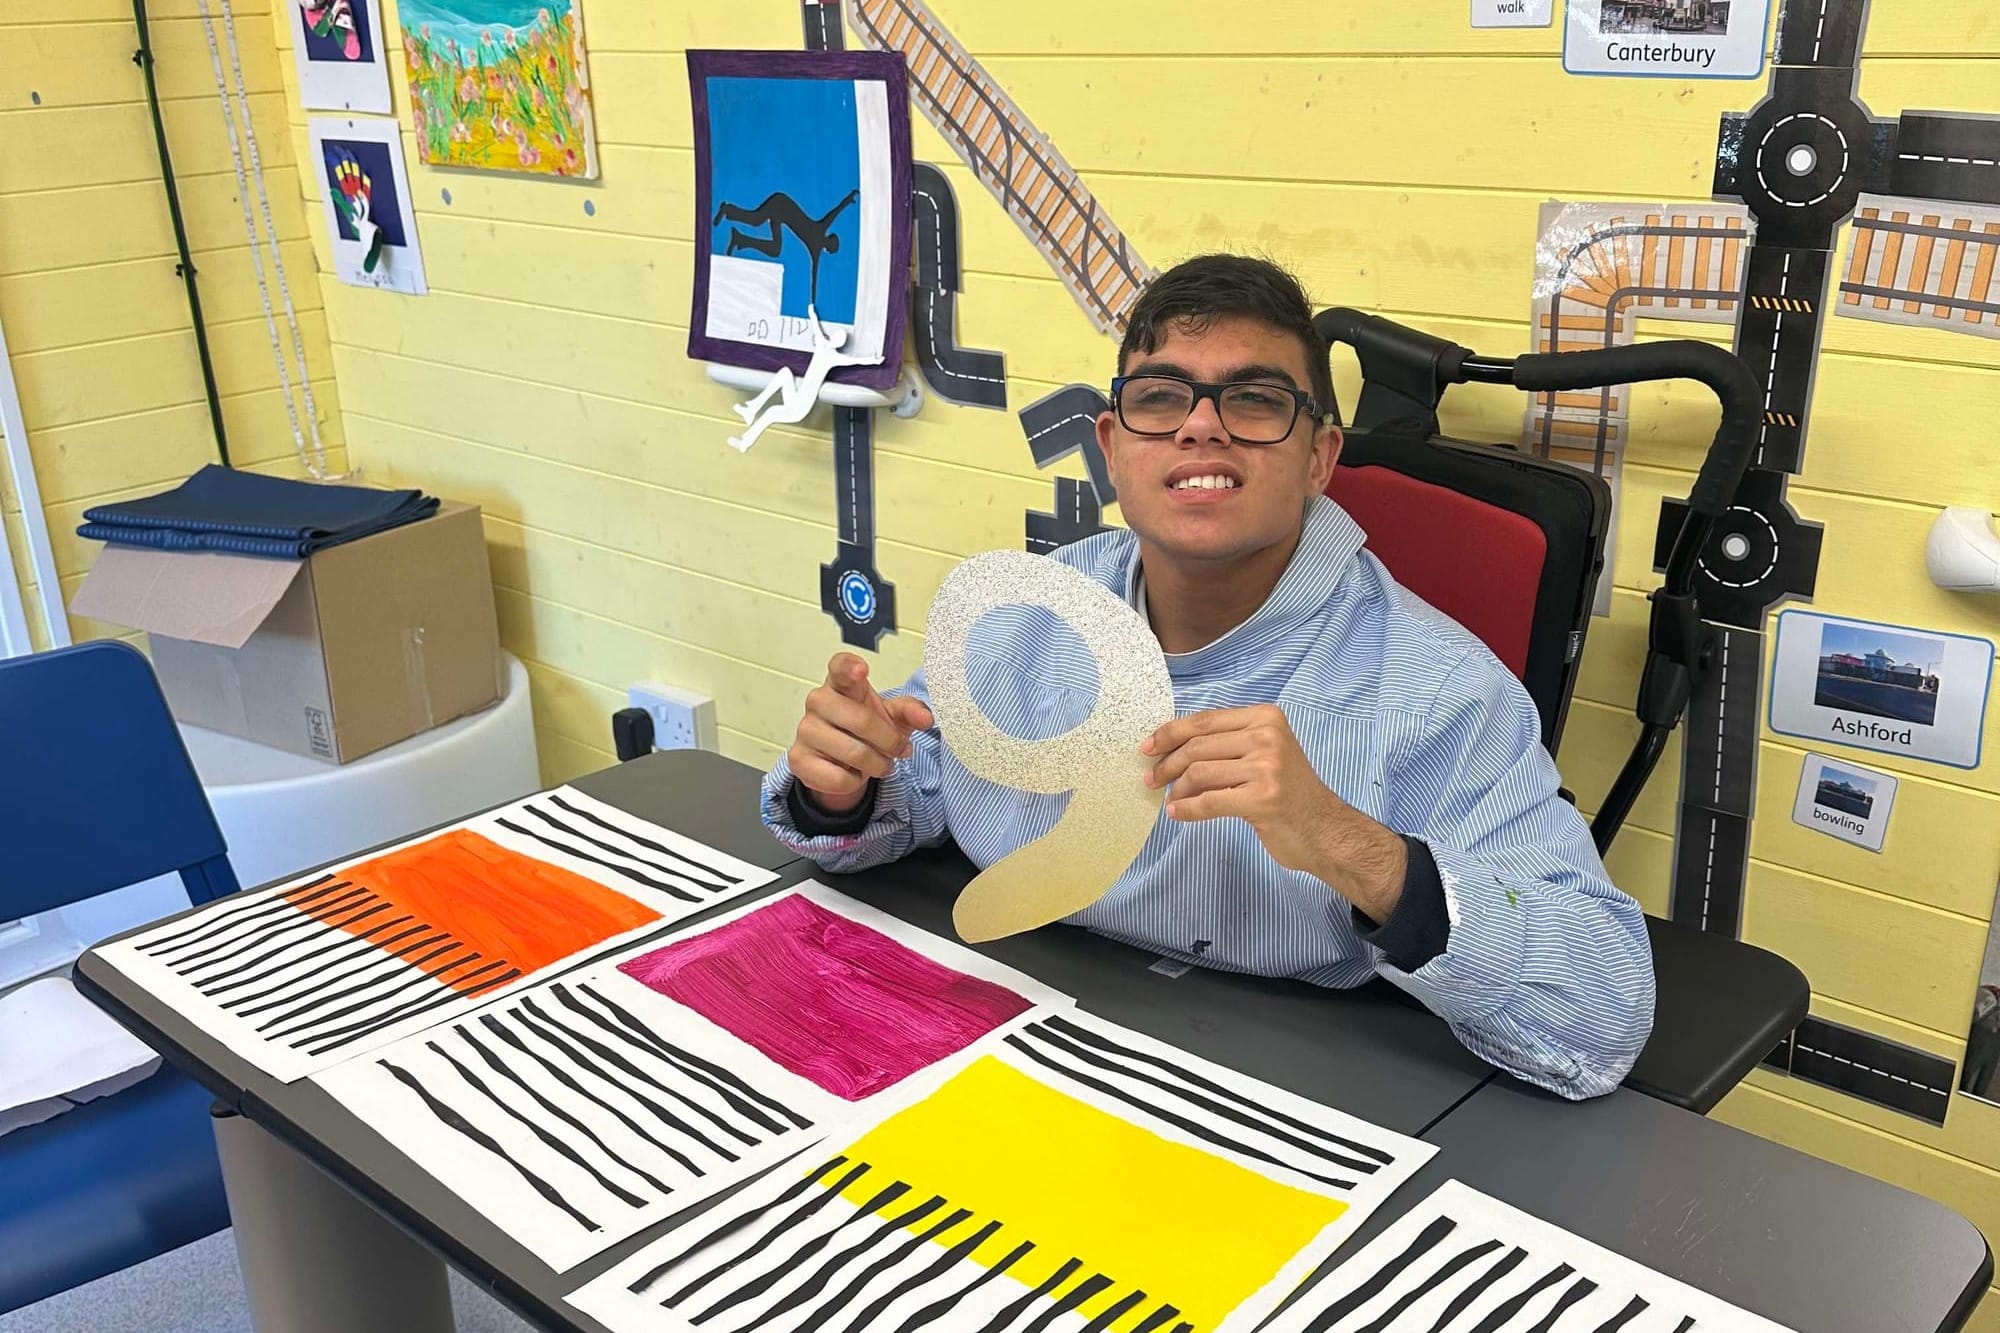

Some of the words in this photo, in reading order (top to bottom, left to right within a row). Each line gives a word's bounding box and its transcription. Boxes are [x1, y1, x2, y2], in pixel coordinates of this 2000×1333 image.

[1497, 0, 1525, 13] walk
[1607, 42, 1716, 68] Canterbury
[1831, 717, 1912, 745] Ashford
[924, 550, 1174, 943] 9
[1813, 808, 1865, 835] bowling
